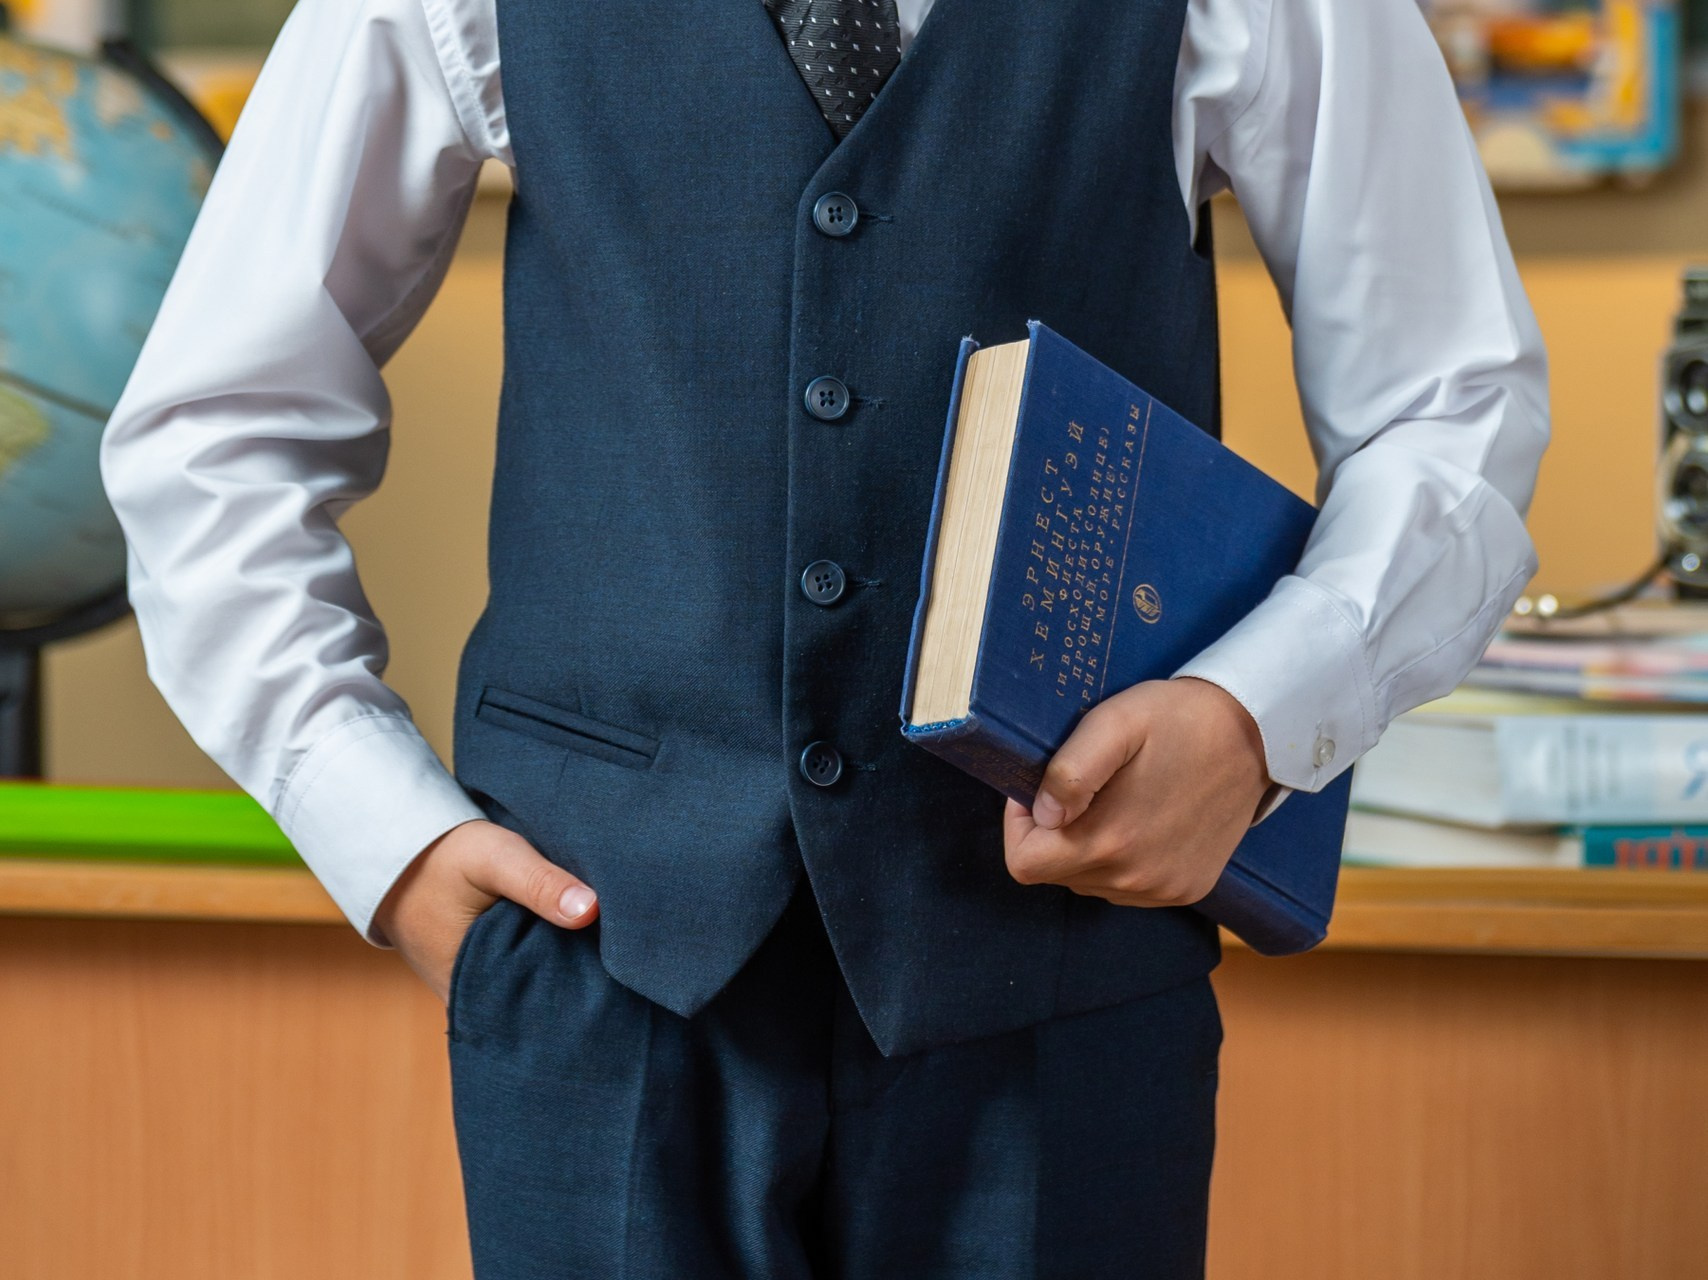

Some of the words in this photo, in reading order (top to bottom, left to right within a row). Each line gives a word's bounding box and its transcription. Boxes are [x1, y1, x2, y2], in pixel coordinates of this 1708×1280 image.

[1091, 464, 1116, 570] ОРУЖИЕ!
[1112, 404, 1140, 530] РАССКАЗЫ
[1022, 459, 1058, 611] ЭРНЕСТ
[1030, 420, 1084, 671] ХЕМИНГУЭЙ
[1059, 507, 1083, 601] ФИЕСТА
[1061, 540, 1090, 666] ВОСХОДИТ
[1084, 427, 1110, 532] СОЛНЦЕ)
[1096, 556, 1114, 621] МОРЕ
[1091, 631, 1102, 646] И
